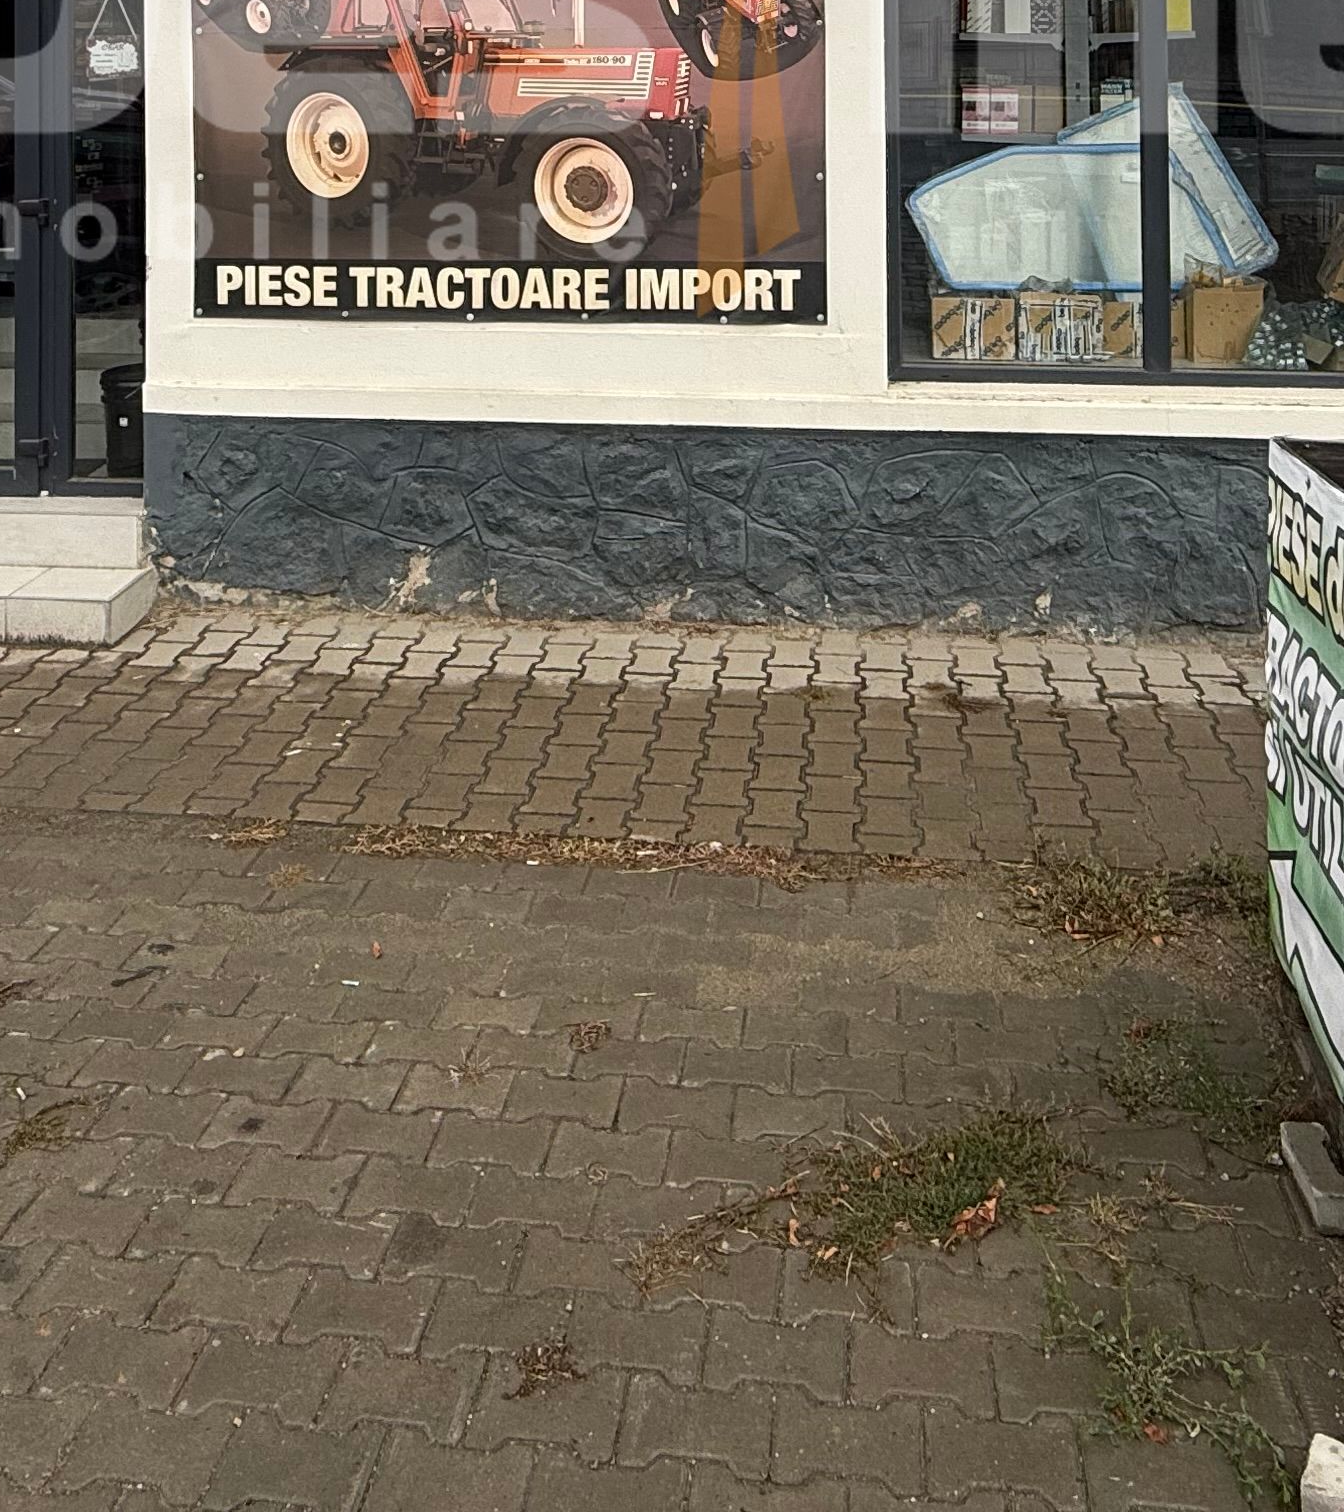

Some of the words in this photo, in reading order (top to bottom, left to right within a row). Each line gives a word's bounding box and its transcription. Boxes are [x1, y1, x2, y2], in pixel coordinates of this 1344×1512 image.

[216, 265, 338, 308] PIESE
[348, 266, 610, 311] TRACTOARE
[625, 267, 801, 312] IMPORT
